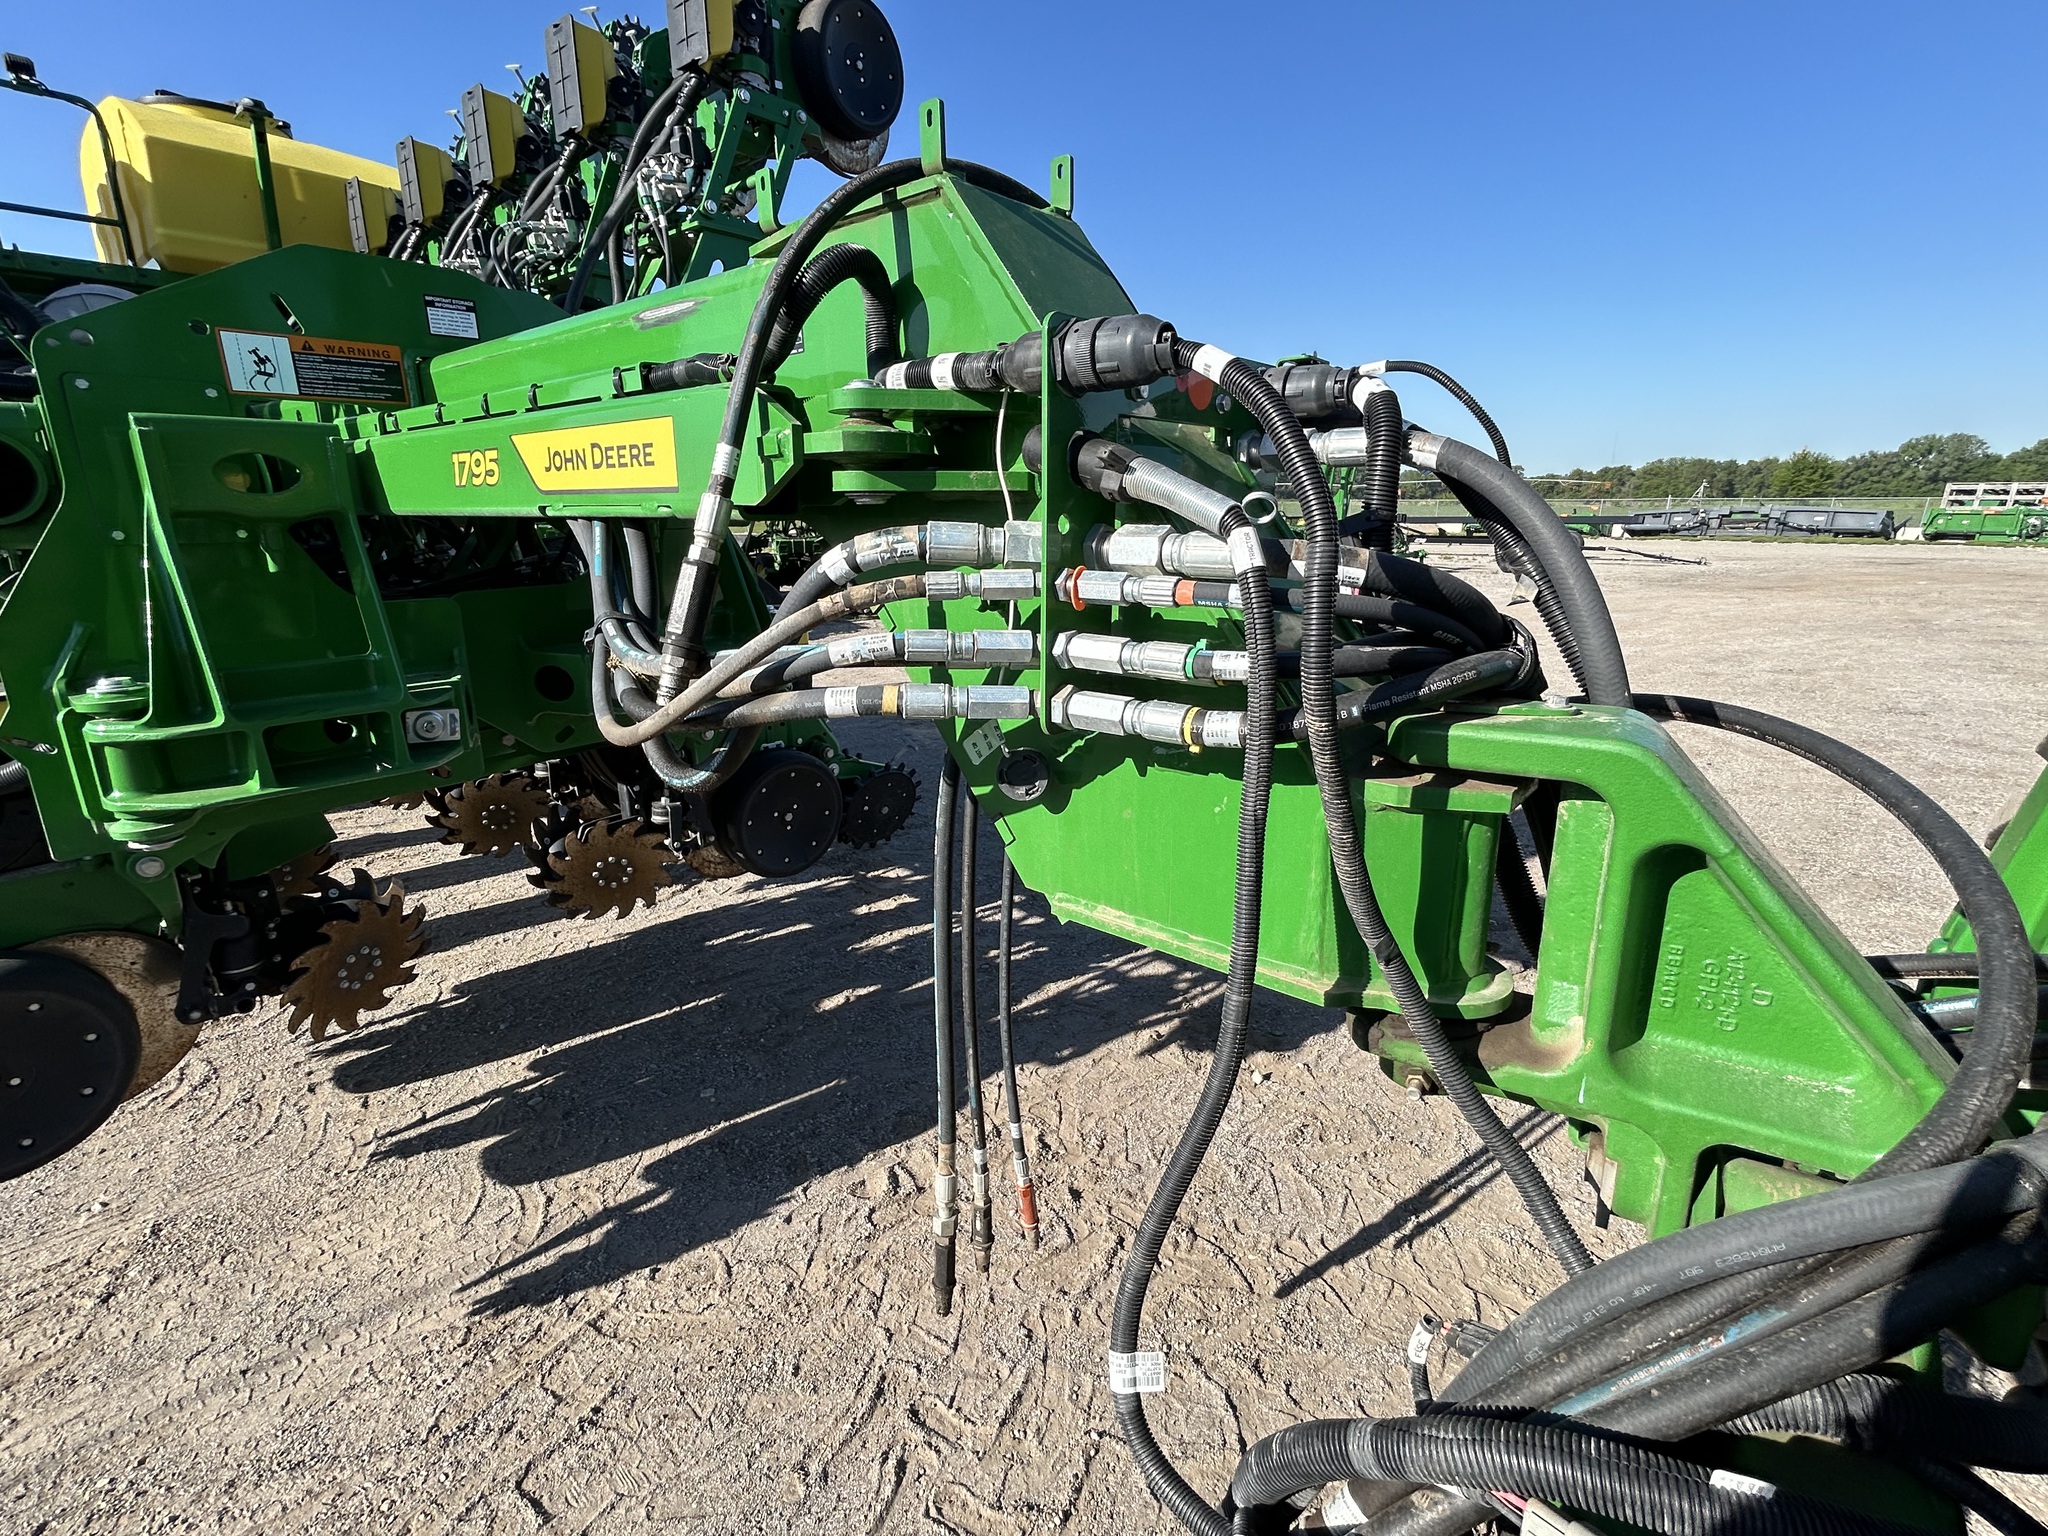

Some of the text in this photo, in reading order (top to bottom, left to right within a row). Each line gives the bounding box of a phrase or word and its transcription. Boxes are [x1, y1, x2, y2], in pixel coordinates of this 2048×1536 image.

[323, 344, 391, 359] WARNING
[452, 448, 499, 487] 1795
[544, 442, 655, 472] JOHN DEERE
[1244, 532, 1256, 561] TRACTOR
[1363, 699, 1391, 713] Flame
[1391, 686, 1430, 705] Resistant
[1430, 679, 1453, 692] MSHA
